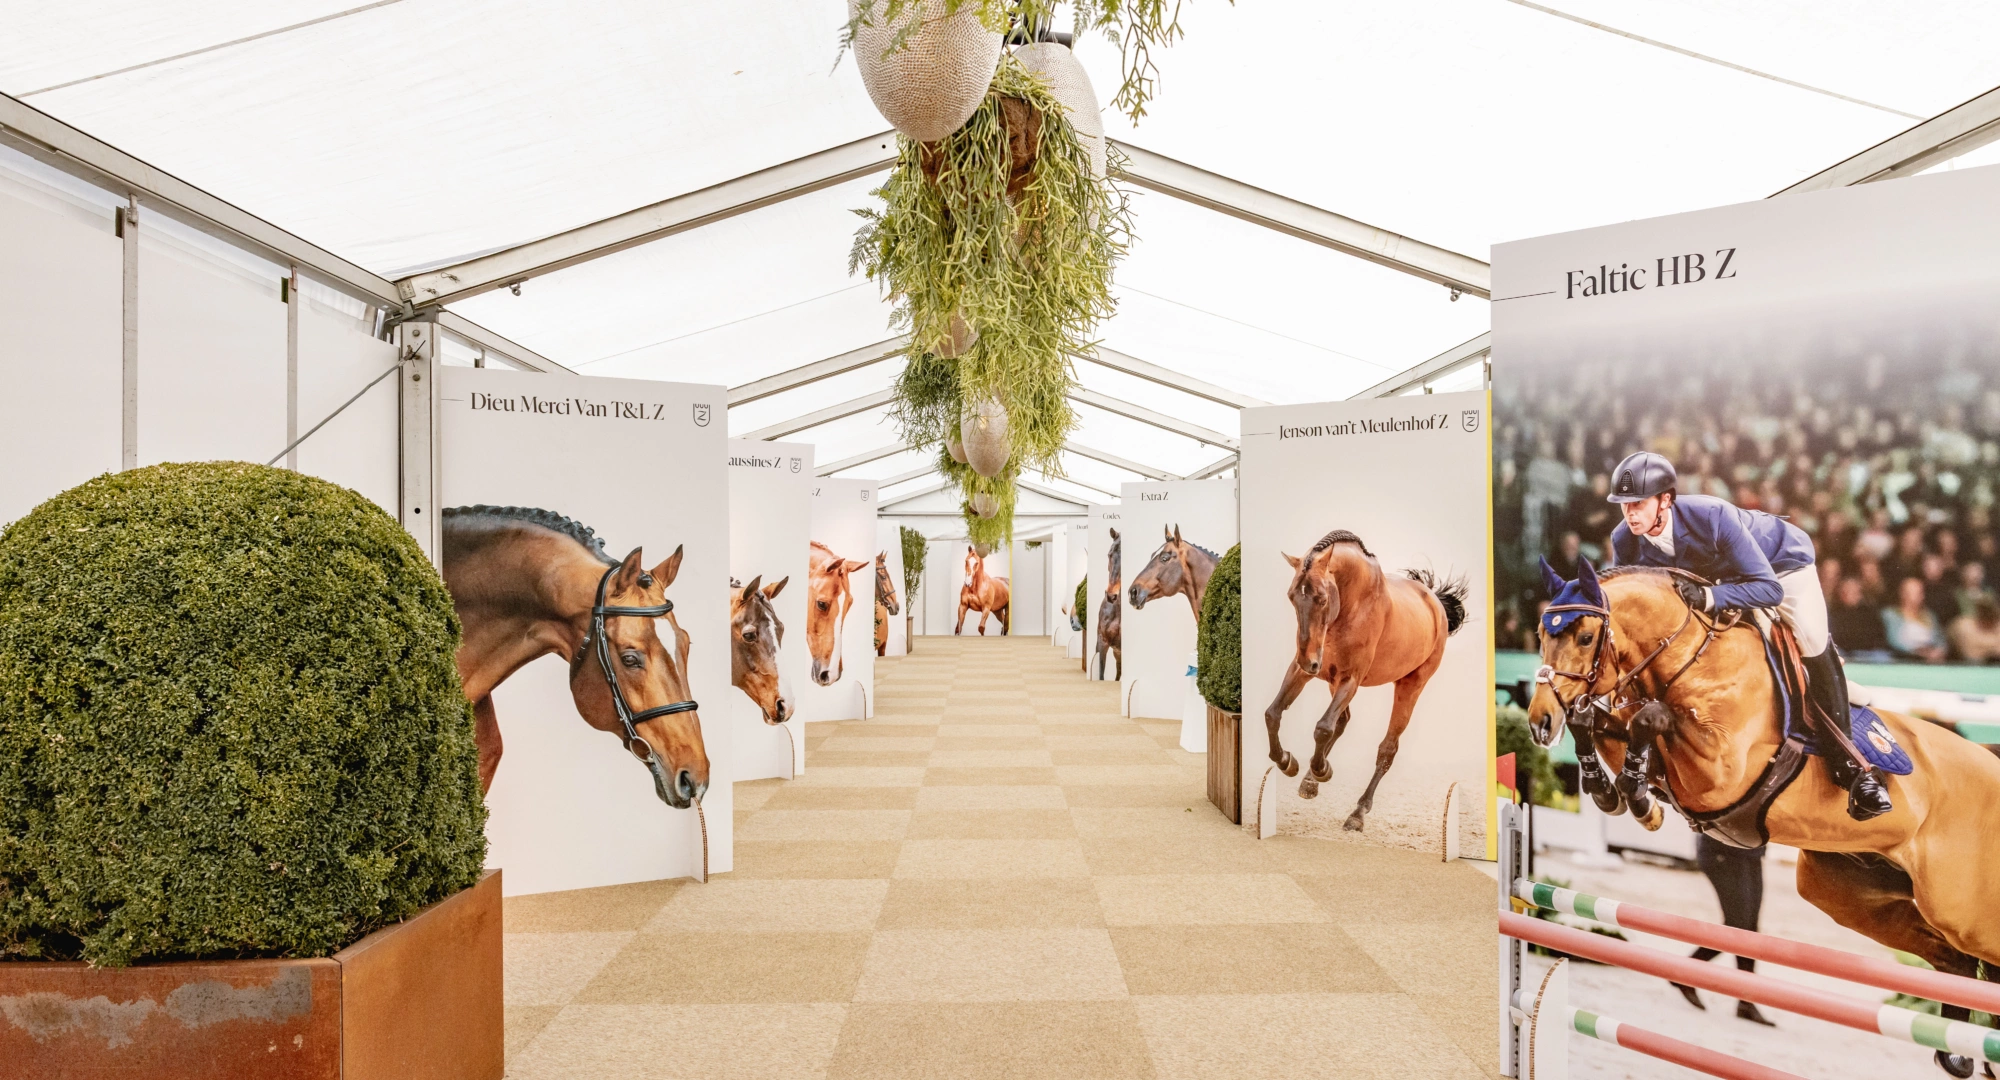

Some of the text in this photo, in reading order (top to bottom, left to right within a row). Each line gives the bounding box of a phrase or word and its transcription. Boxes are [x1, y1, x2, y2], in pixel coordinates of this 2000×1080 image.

[1566, 247, 1737, 299] Faltic HB Z
[470, 392, 665, 420] Dieu Merci Van T&L Z
[1279, 414, 1449, 440] Jenson van't Meulenhof Z
[728, 455, 781, 468] aussines Z
[1141, 491, 1169, 501] Extra Z
